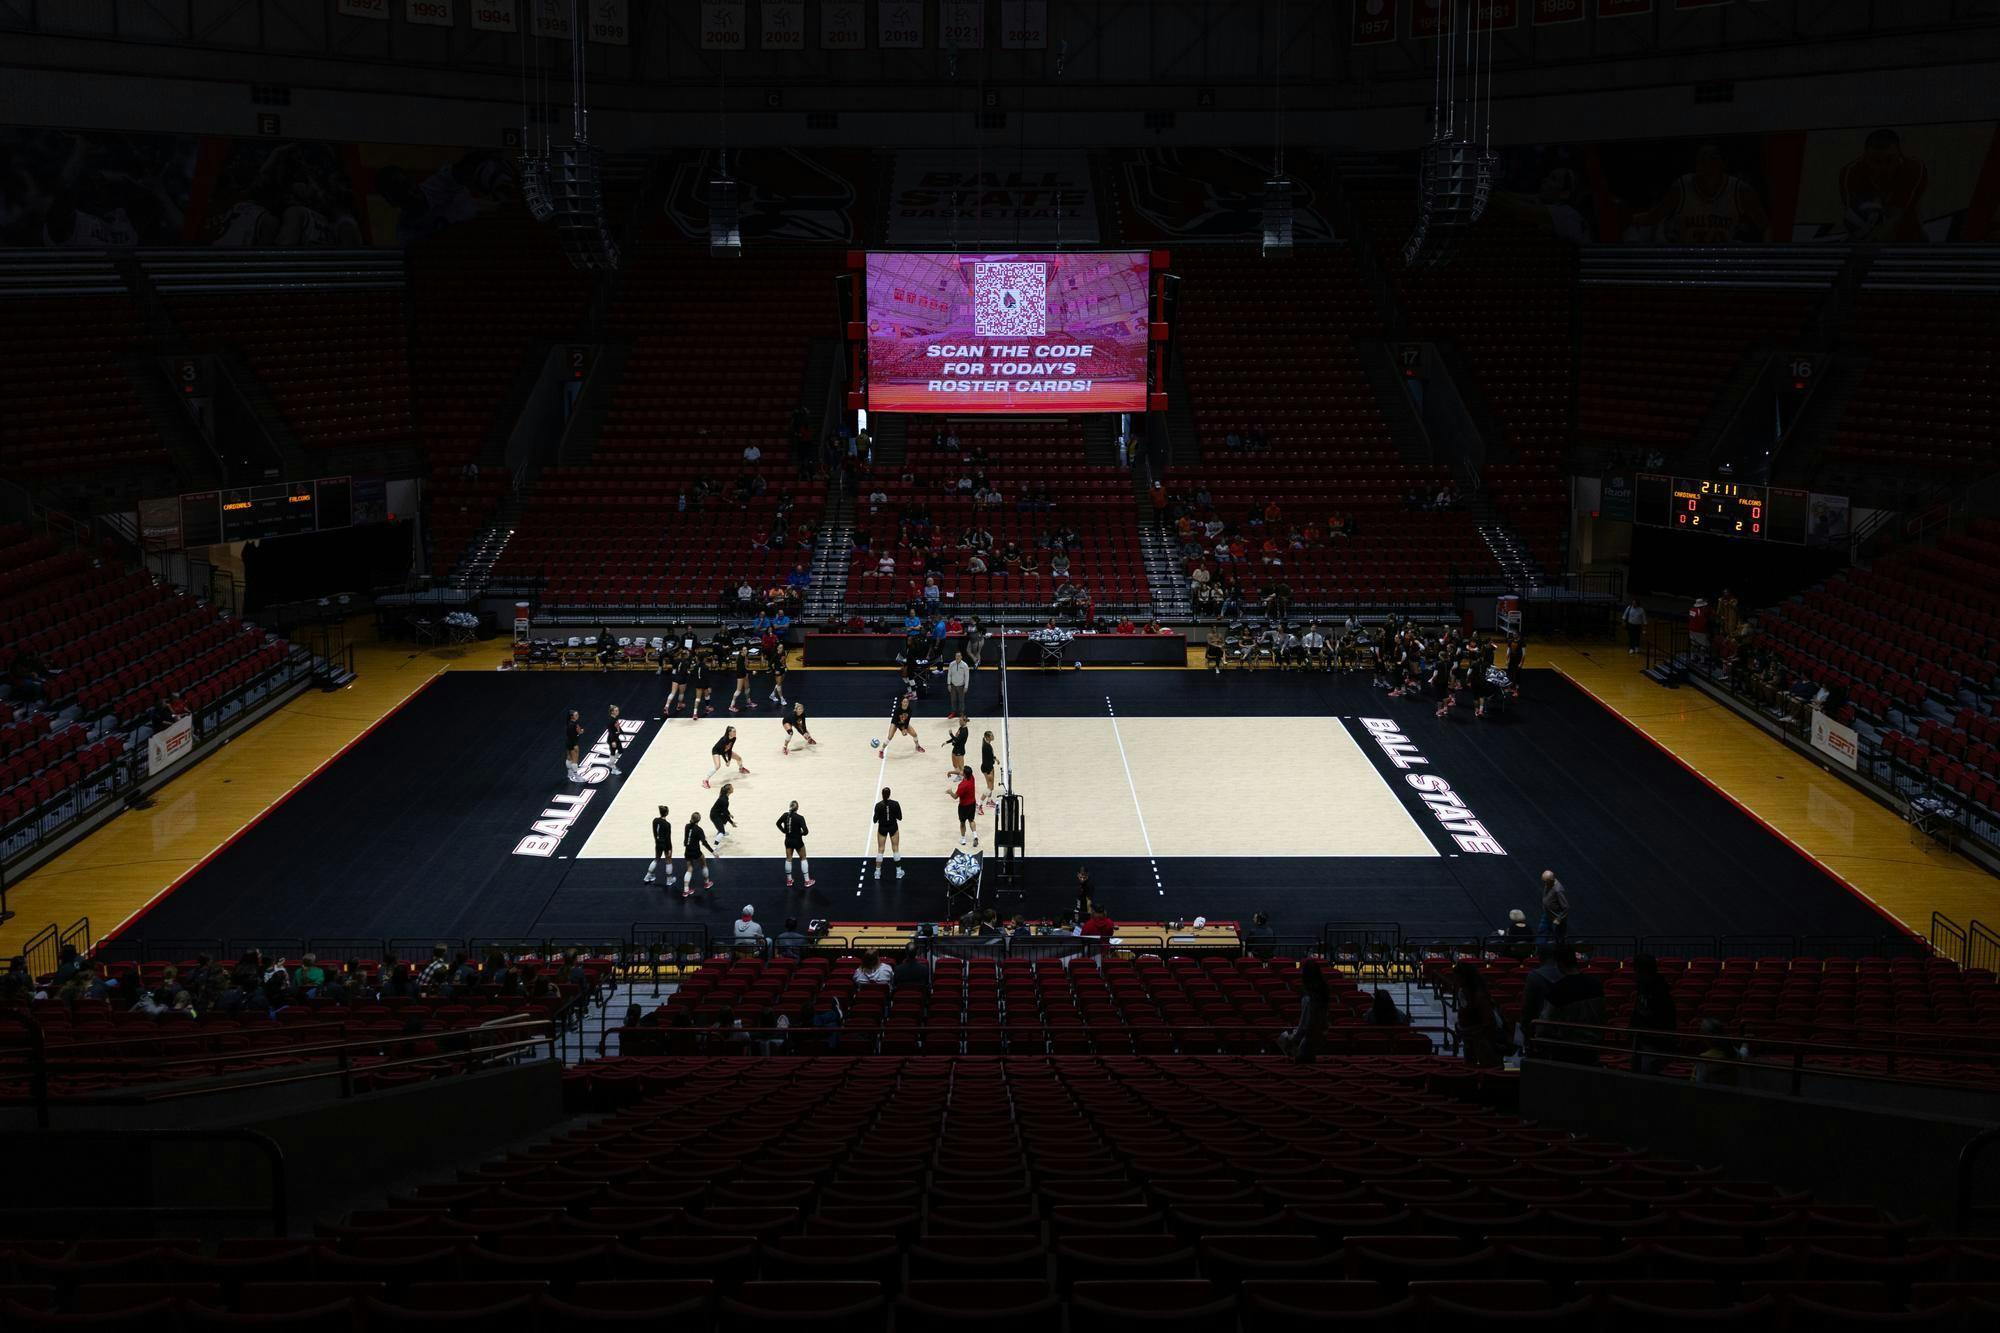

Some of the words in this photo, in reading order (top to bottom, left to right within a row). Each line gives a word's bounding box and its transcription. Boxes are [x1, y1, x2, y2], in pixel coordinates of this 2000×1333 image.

[414, 3, 448, 18] 1993
[478, 9, 510, 25] 1994
[592, 21, 624, 38] 1999
[1360, 19, 1389, 34] 1957
[706, 31, 739, 43] 2000
[767, 31, 800, 42] 2002
[830, 31, 857, 42] 2011
[885, 30, 918, 42] 2019
[1008, 31, 1040, 41] 2022
[899, 208, 1082, 218] BASKETBALL
[926, 345, 984, 358] SCAN
[989, 345, 1030, 358] THE
[1034, 345, 1094, 358] CODE
[1401, 351, 1419, 365] 17
[573, 352, 585, 367] 2
[182, 365, 197, 381] 3
[942, 362, 985, 375] FOR
[991, 362, 1077, 375] TODAY'S
[1788, 361, 1812, 378] 16
[927, 380, 1011, 393] ROSTER
[1014, 380, 1093, 393] CARDS!
[1701, 481, 1738, 496] 21:11
[1688, 499, 1697, 511] 0
[1738, 498, 1762, 507] FALCONS
[1679, 514, 1687, 524] 0
[1751, 506, 1761, 519] 0
[1692, 515, 1700, 525] 2
[1735, 521, 1743, 531] 2
[1752, 523, 1760, 533] 0
[1828, 731, 1856, 755] ESPN
[1358, 717, 1430, 769] BALL
[1405, 773, 1508, 856] STATE
[512, 788, 597, 857] BALL
